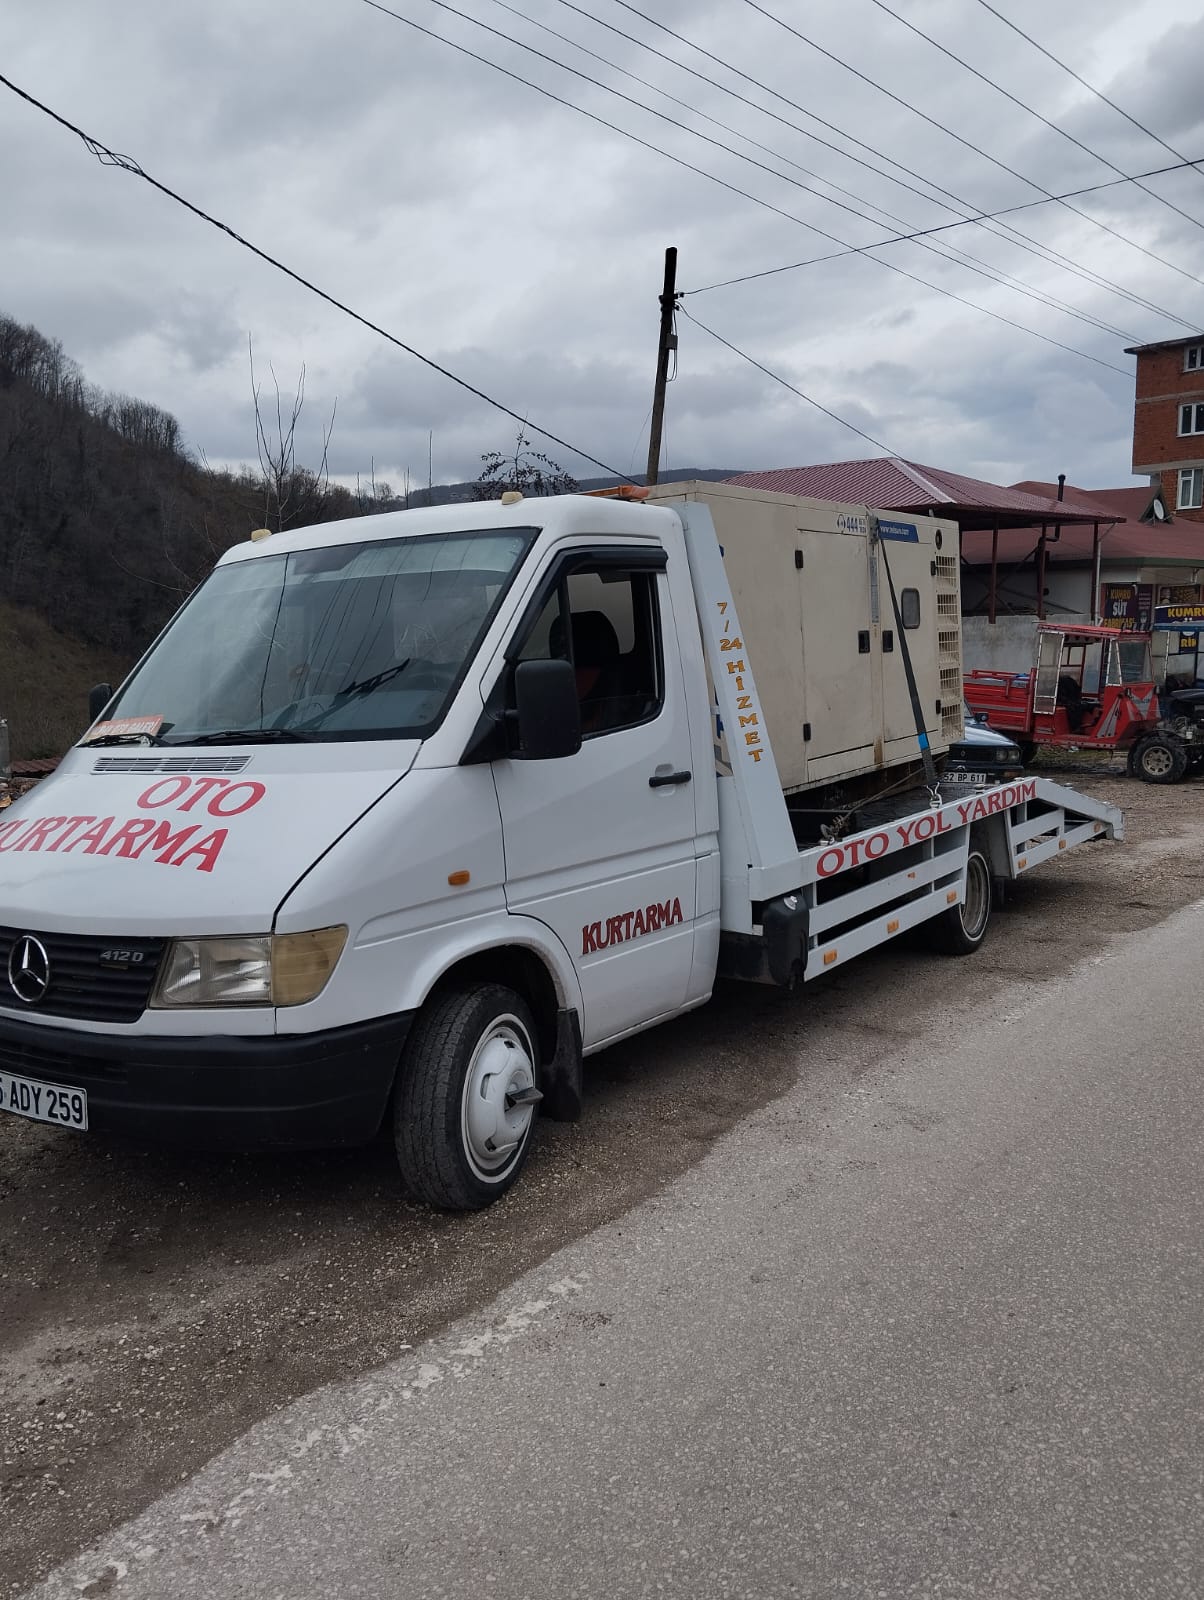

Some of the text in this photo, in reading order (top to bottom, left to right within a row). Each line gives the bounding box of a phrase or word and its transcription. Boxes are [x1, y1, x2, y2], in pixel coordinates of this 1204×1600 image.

[1112, 598, 1128, 616] SÜT
[1167, 607, 1204, 618] KUMR
[137, 775, 267, 817] OTO
[943, 772, 985, 782] 52 BP 611
[816, 780, 1037, 877] OTO YOL YARDIM
[582, 897, 684, 955] KURTARMA
[10, 1080, 42, 1115] ADY
[46, 1089, 83, 1125] 259
